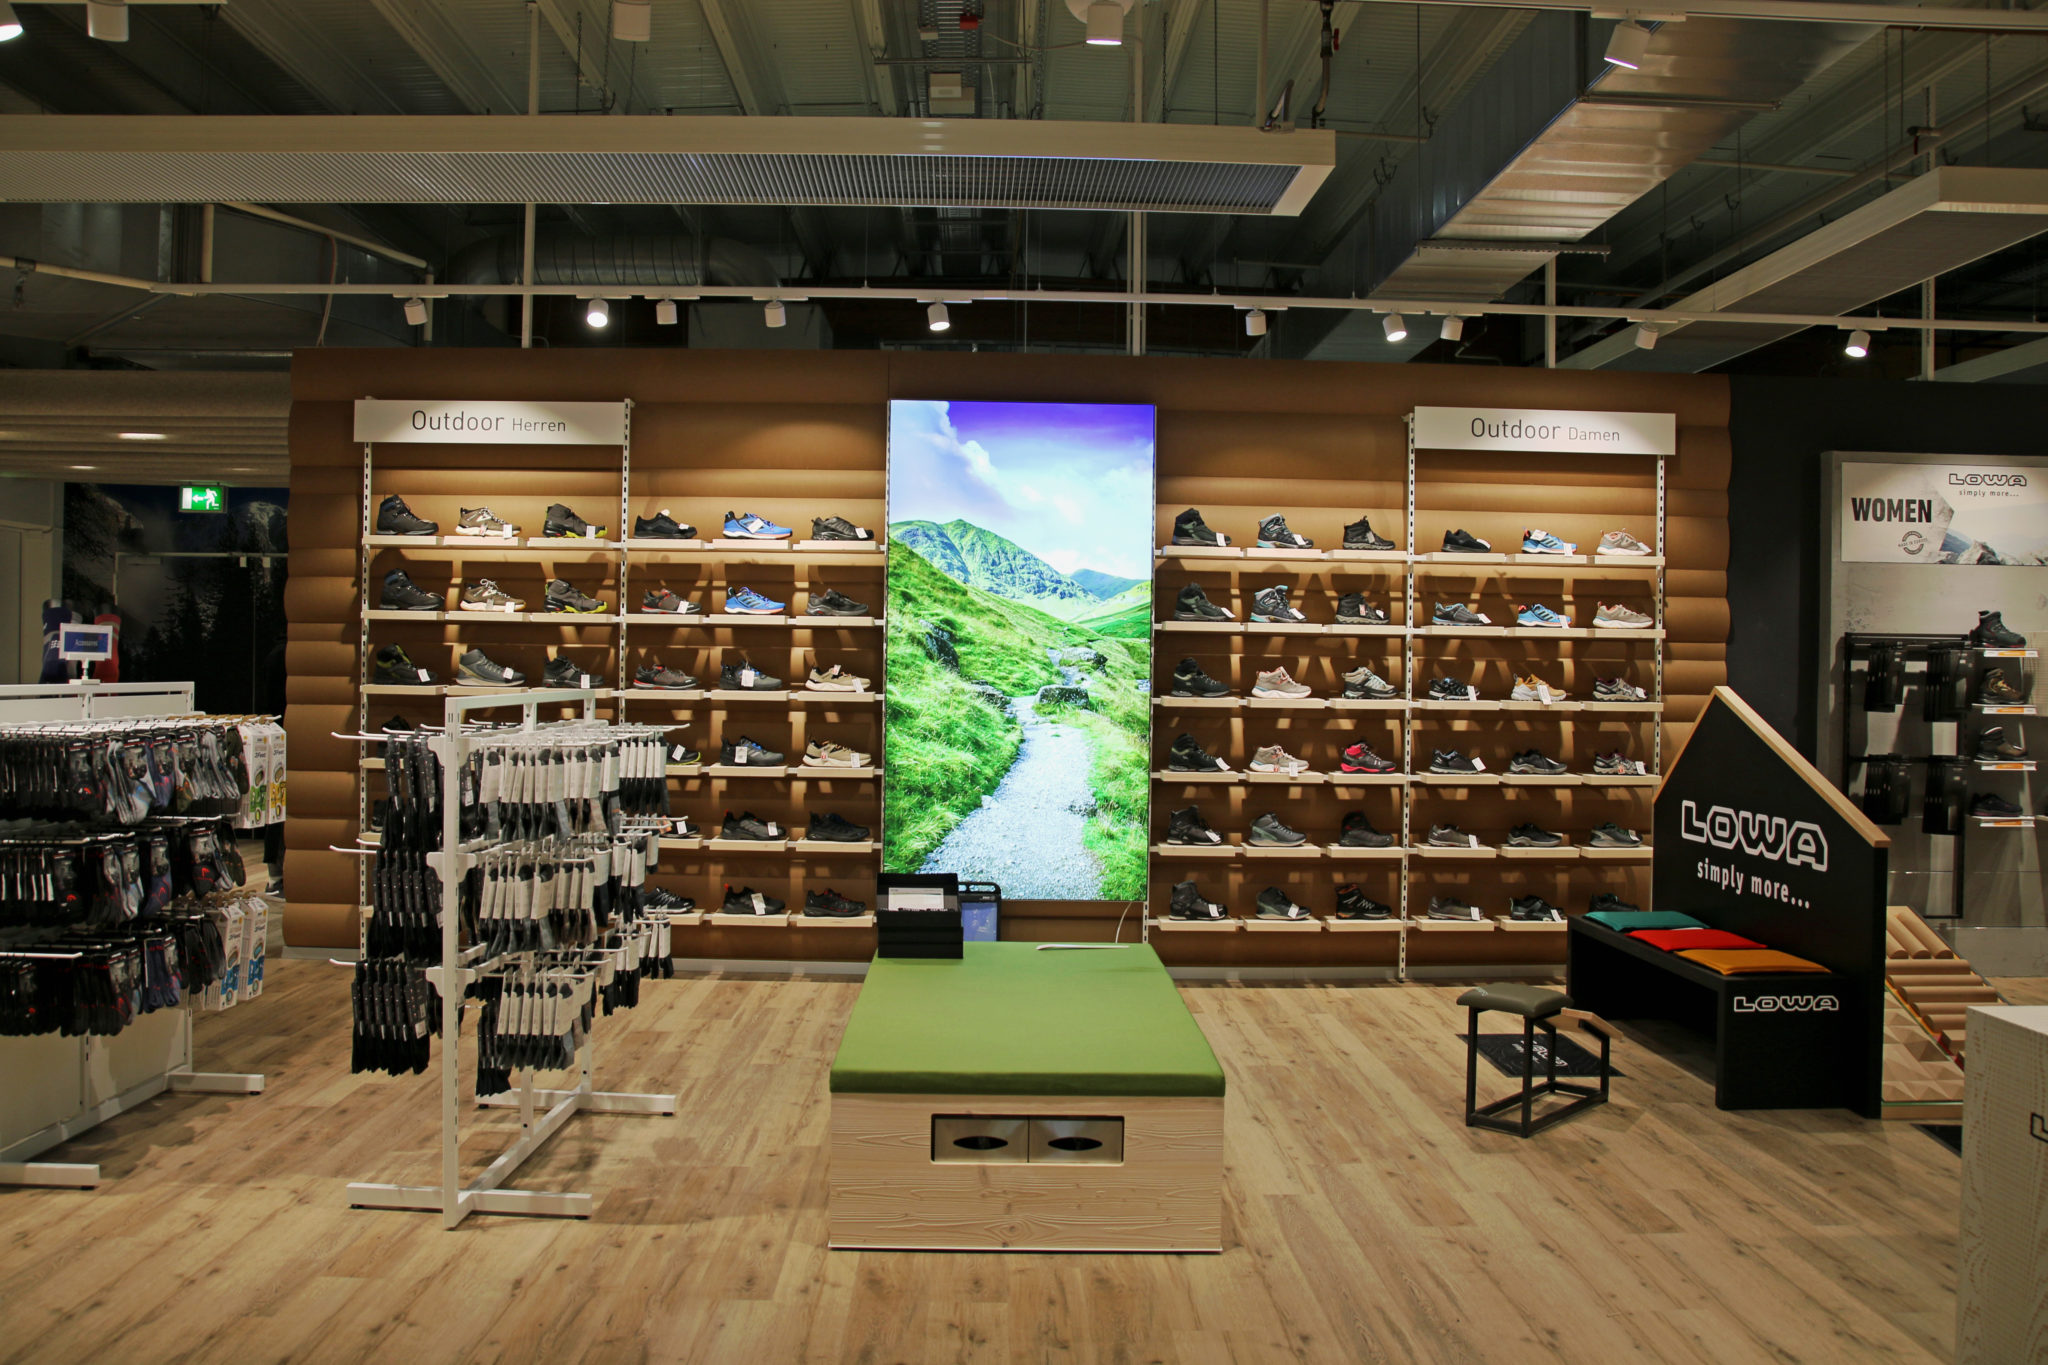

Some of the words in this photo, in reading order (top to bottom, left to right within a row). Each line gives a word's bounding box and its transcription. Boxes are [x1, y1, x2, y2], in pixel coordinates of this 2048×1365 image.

[412, 410, 505, 431] Outdoor
[512, 418, 566, 432] Herren
[1471, 417, 1560, 439] Outdoor
[1568, 427, 1620, 441] Damen
[1949, 473, 2027, 487] LOWA
[1959, 489, 1986, 497] simply
[1851, 497, 1932, 523] WOMEN
[1681, 799, 1829, 873] LOWA
[1697, 857, 1744, 895] simply
[1750, 875, 1810, 910] more...
[1734, 995, 1839, 1012] LOWA
